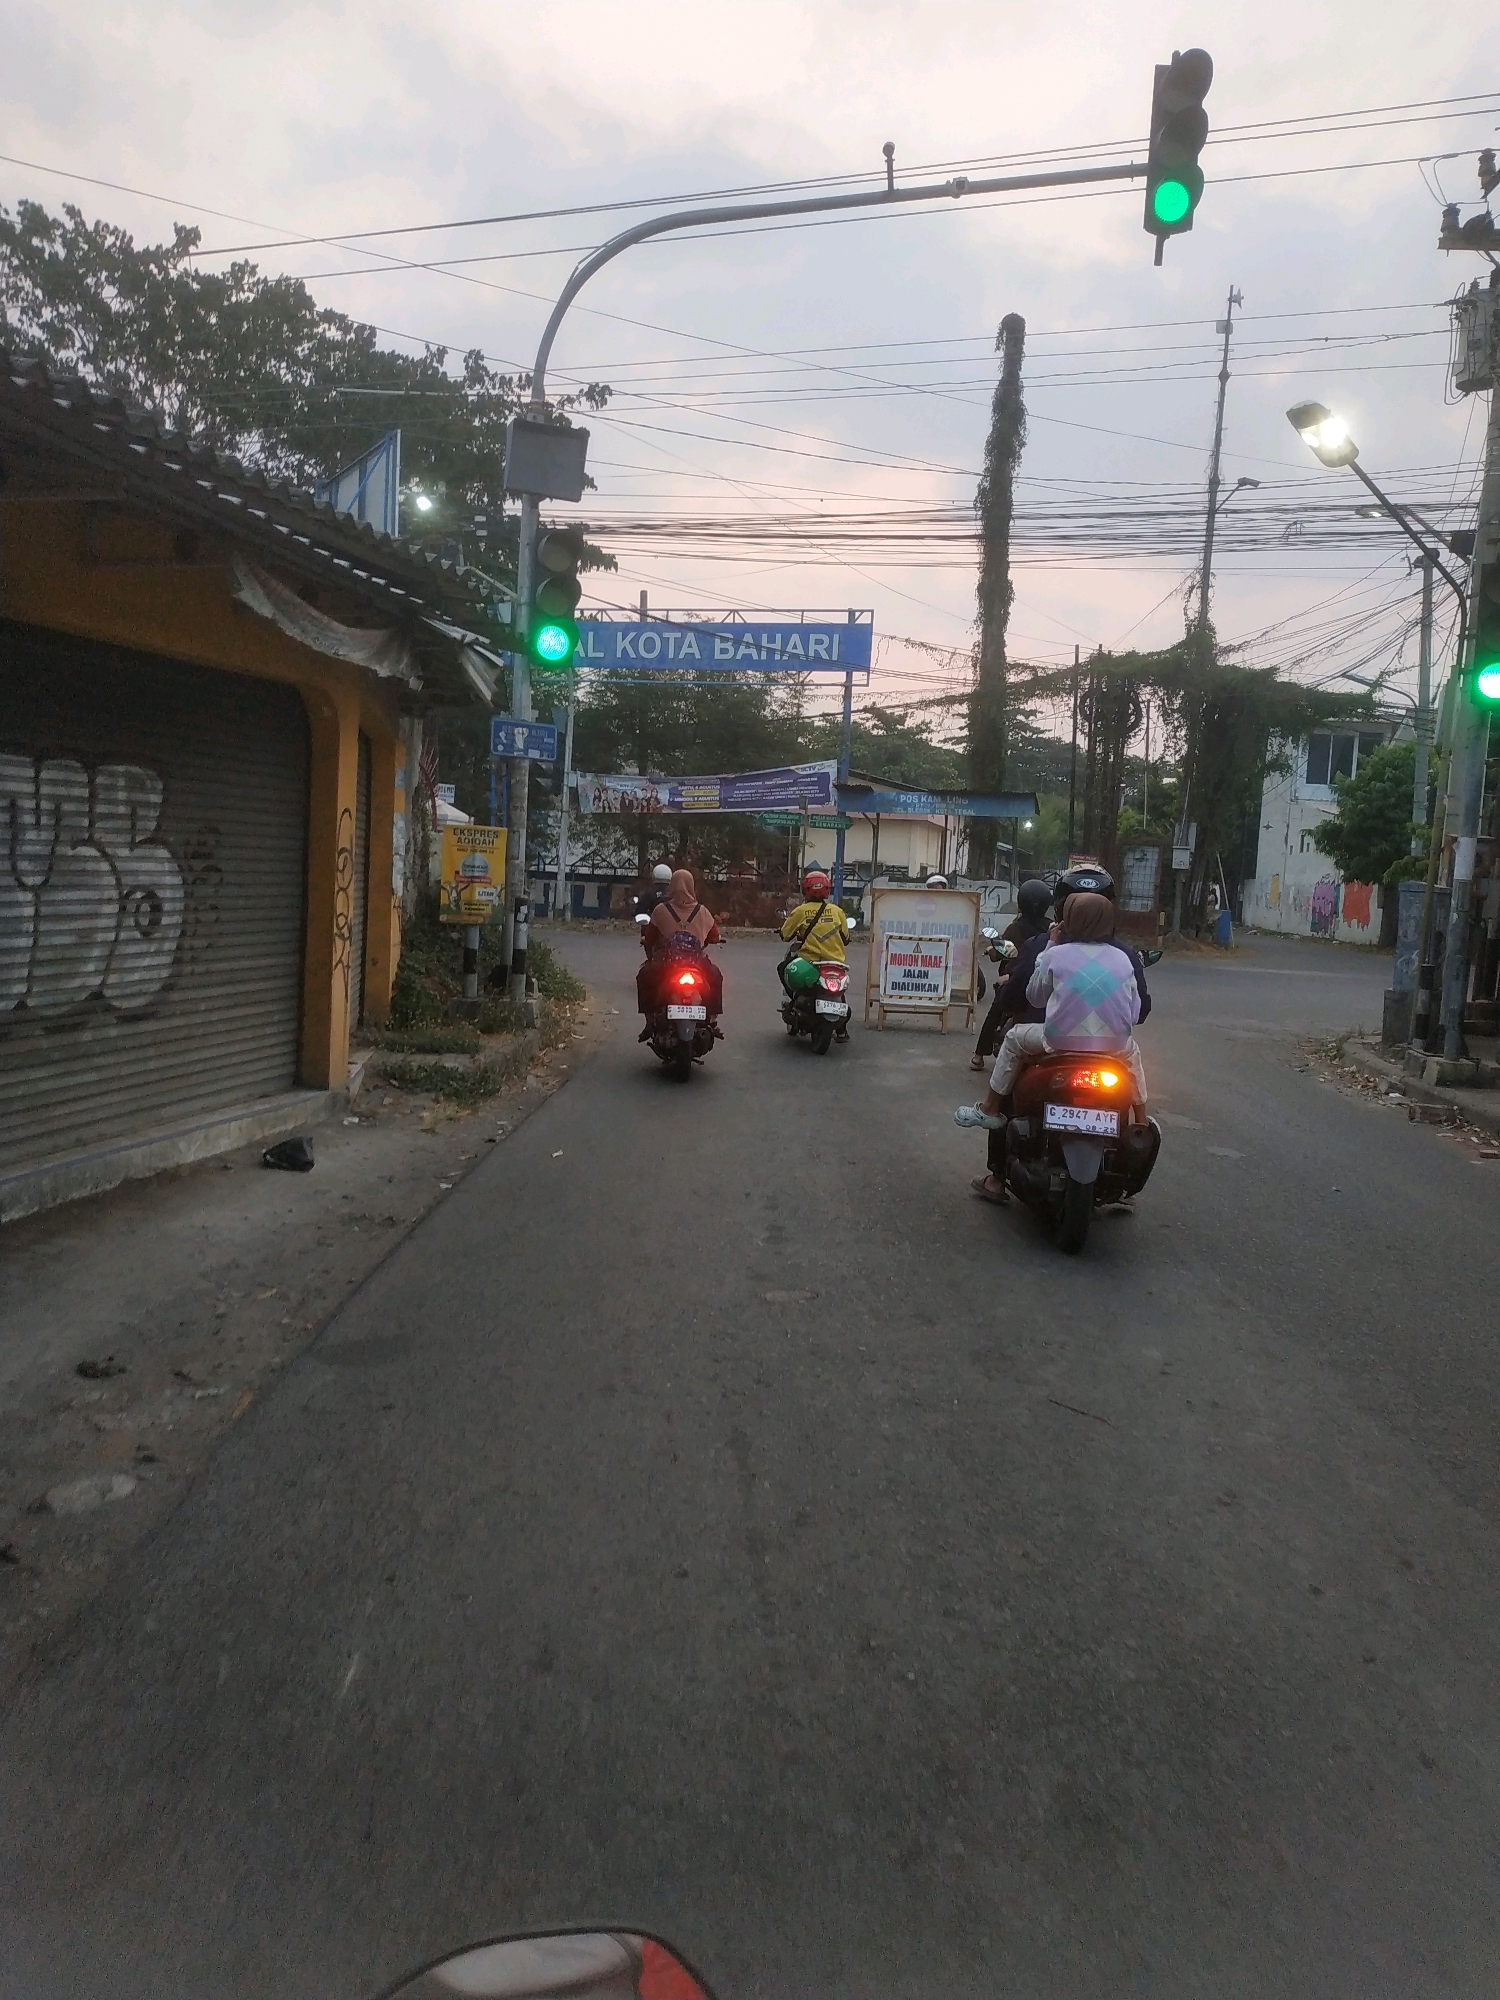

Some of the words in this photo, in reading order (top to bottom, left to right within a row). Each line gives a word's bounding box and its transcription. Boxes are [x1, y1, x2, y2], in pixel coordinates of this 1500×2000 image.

[616, 631, 701, 659] KOTA
[714, 632, 840, 661] BAHARI
[900, 794, 918, 803] POS
[921, 795, 941, 803] KAM
[453, 828, 499, 838] EKSPRES
[889, 953, 919, 967] MOHON
[920, 954, 943, 968] MAAF
[902, 969, 930, 979] JALAN
[891, 981, 940, 993] DIALIHKAN
[1050, 1106, 1056, 1117] G
[1062, 1108, 1089, 1121] 2947
[1095, 1112, 1117, 1123] AYF
